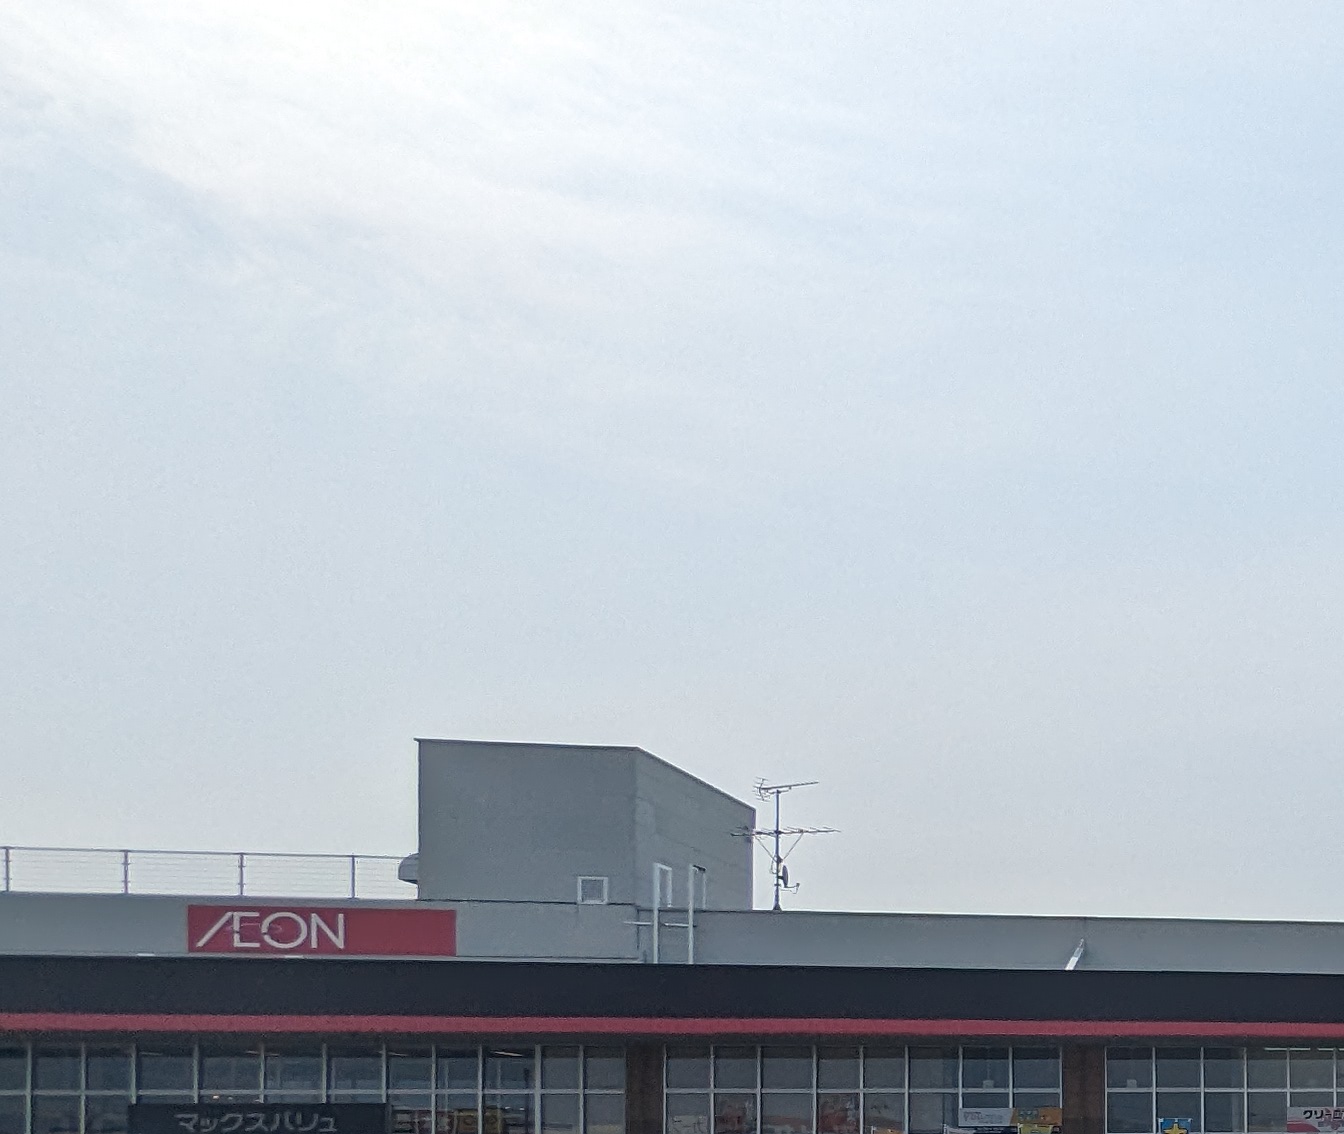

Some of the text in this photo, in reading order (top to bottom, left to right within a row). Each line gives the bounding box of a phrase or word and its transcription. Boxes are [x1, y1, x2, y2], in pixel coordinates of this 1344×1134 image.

[174, 1112, 338, 1133] マックスバリュ
